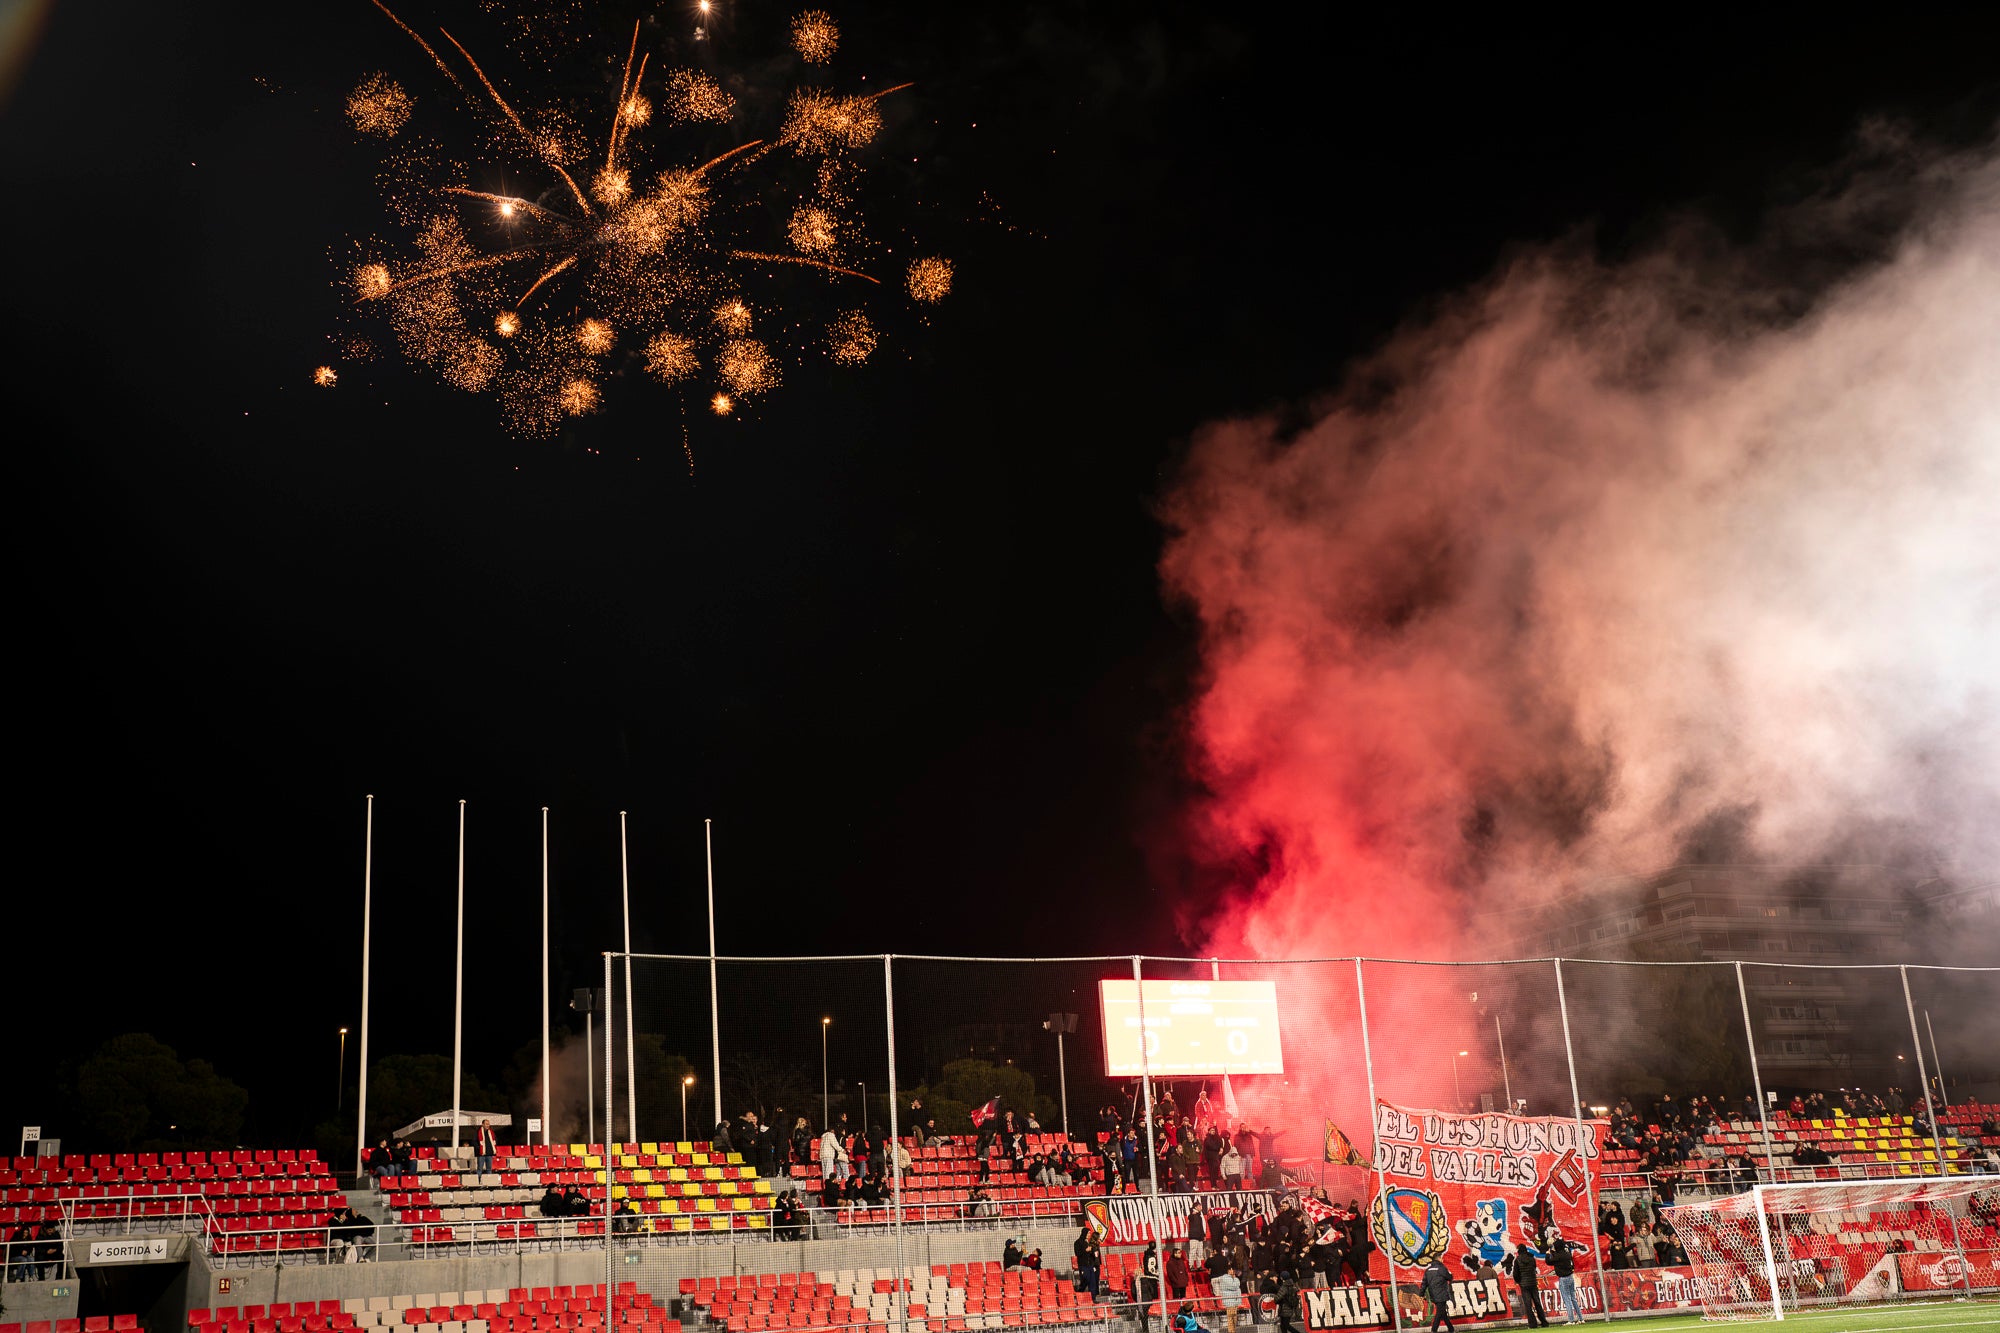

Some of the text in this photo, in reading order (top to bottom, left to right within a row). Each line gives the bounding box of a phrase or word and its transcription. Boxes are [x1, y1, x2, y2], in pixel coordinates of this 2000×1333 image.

[1379, 1105, 1598, 1158] EL DESHONOR
[1373, 1142, 1538, 1188] DEL VALLÈS
[106, 1246, 151, 1257] SORTIDA
[1306, 1288, 1392, 1328] MALA
[1446, 1278, 1507, 1319] AÇA
